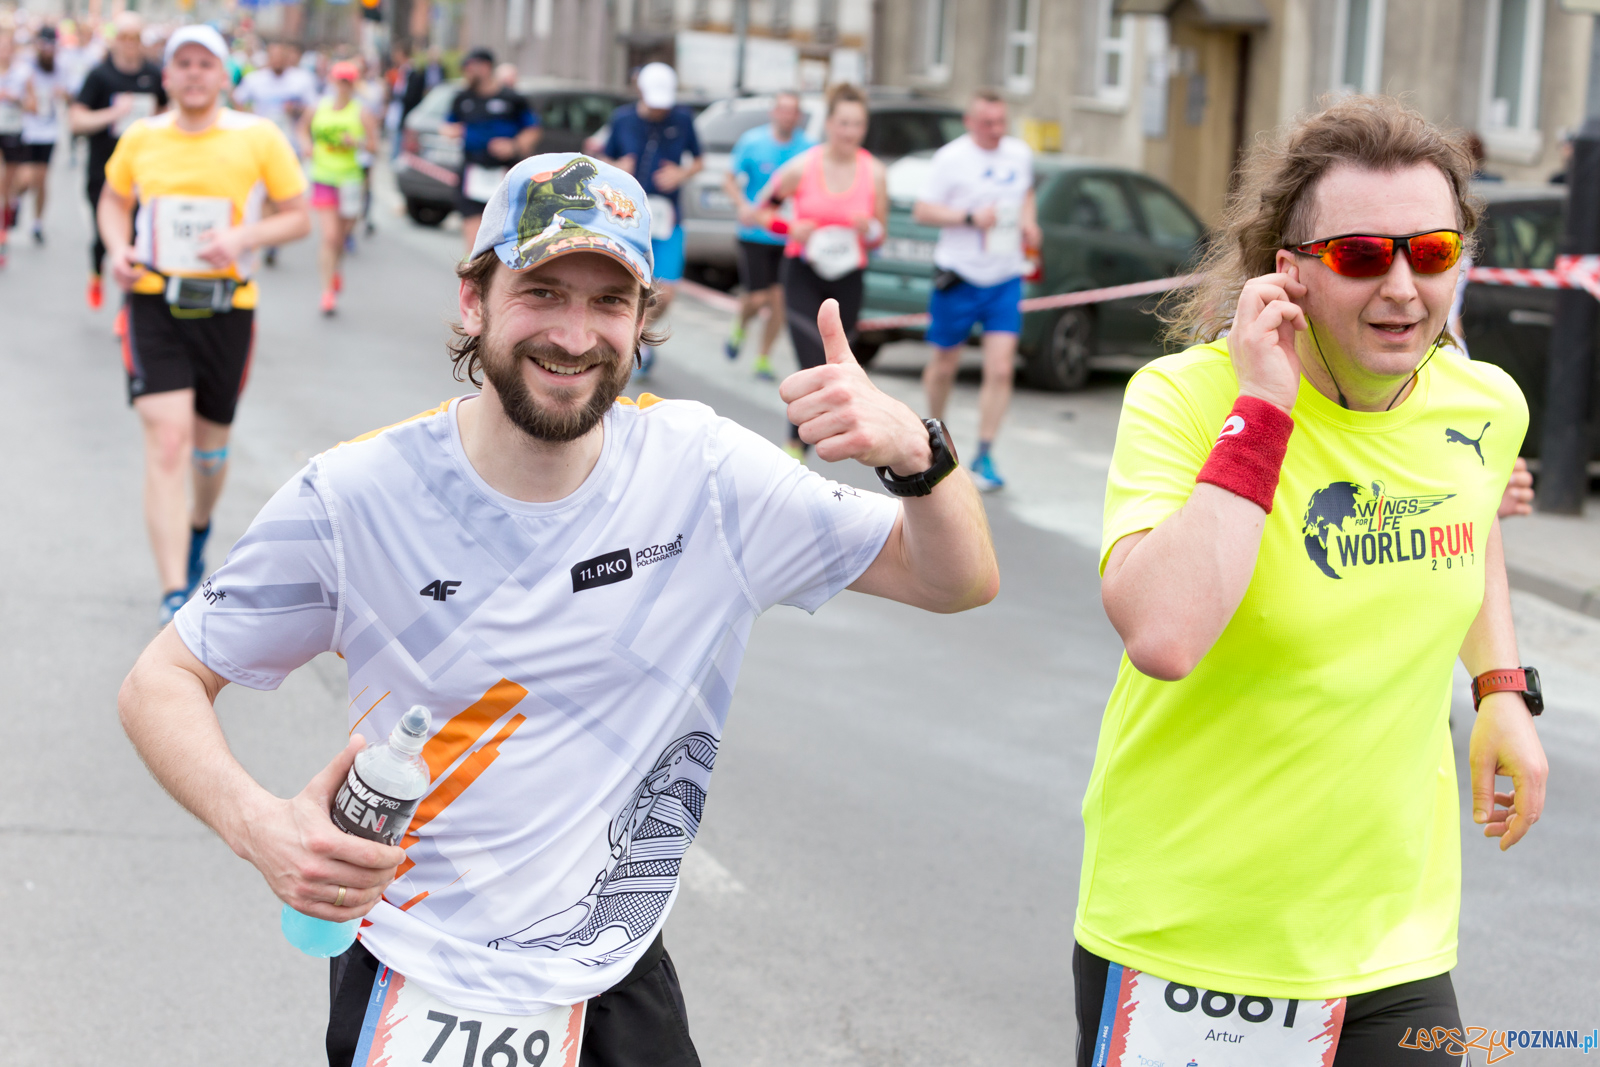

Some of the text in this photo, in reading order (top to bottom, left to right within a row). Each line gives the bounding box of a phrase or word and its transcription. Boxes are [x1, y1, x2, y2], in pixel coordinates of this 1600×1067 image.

[1357, 496, 1419, 518] WINGS
[1355, 515, 1403, 533] FOR LIFE
[1336, 522, 1474, 568] WORLD RUN
[579, 558, 628, 582] 11. PKO
[419, 579, 463, 602] 4F
[335, 779, 389, 834] MEN
[380, 799, 401, 810] PRO
[421, 1009, 550, 1067] 7169
[1205, 1029, 1245, 1044] Artur
